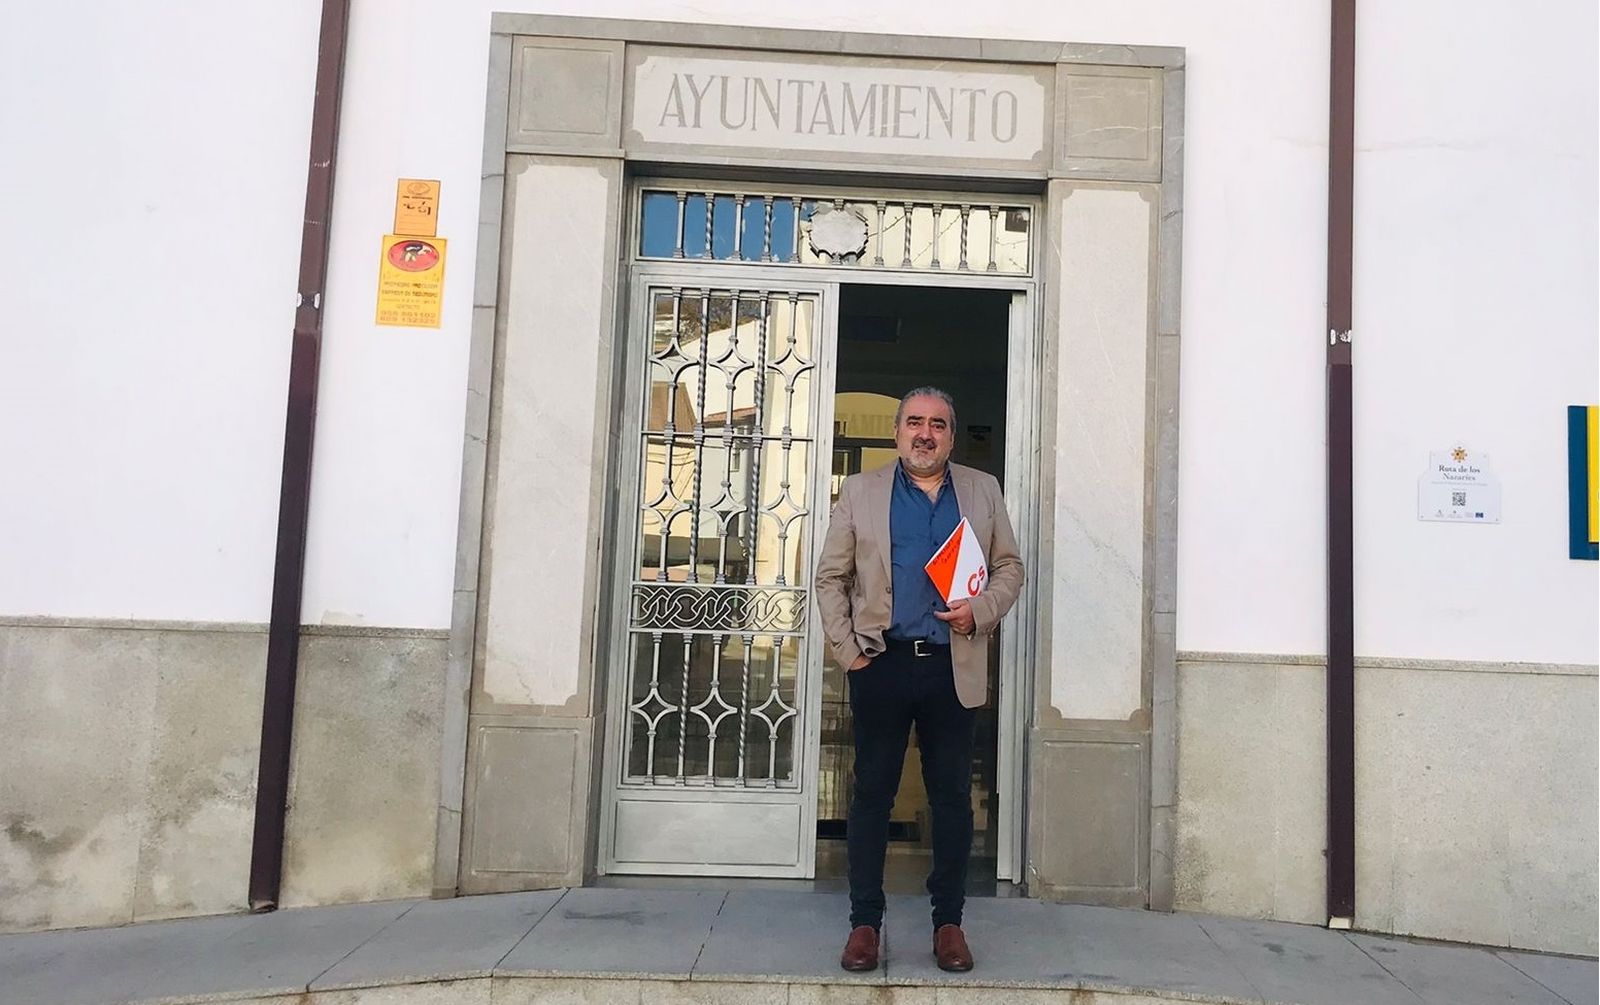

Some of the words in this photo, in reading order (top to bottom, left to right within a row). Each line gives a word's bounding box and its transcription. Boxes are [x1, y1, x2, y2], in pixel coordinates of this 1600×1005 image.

[658, 72, 1018, 143] AYUNTAMIENTO
[1458, 465, 1468, 473] de
[1469, 465, 1480, 473] los
[967, 565, 986, 596] Cs
